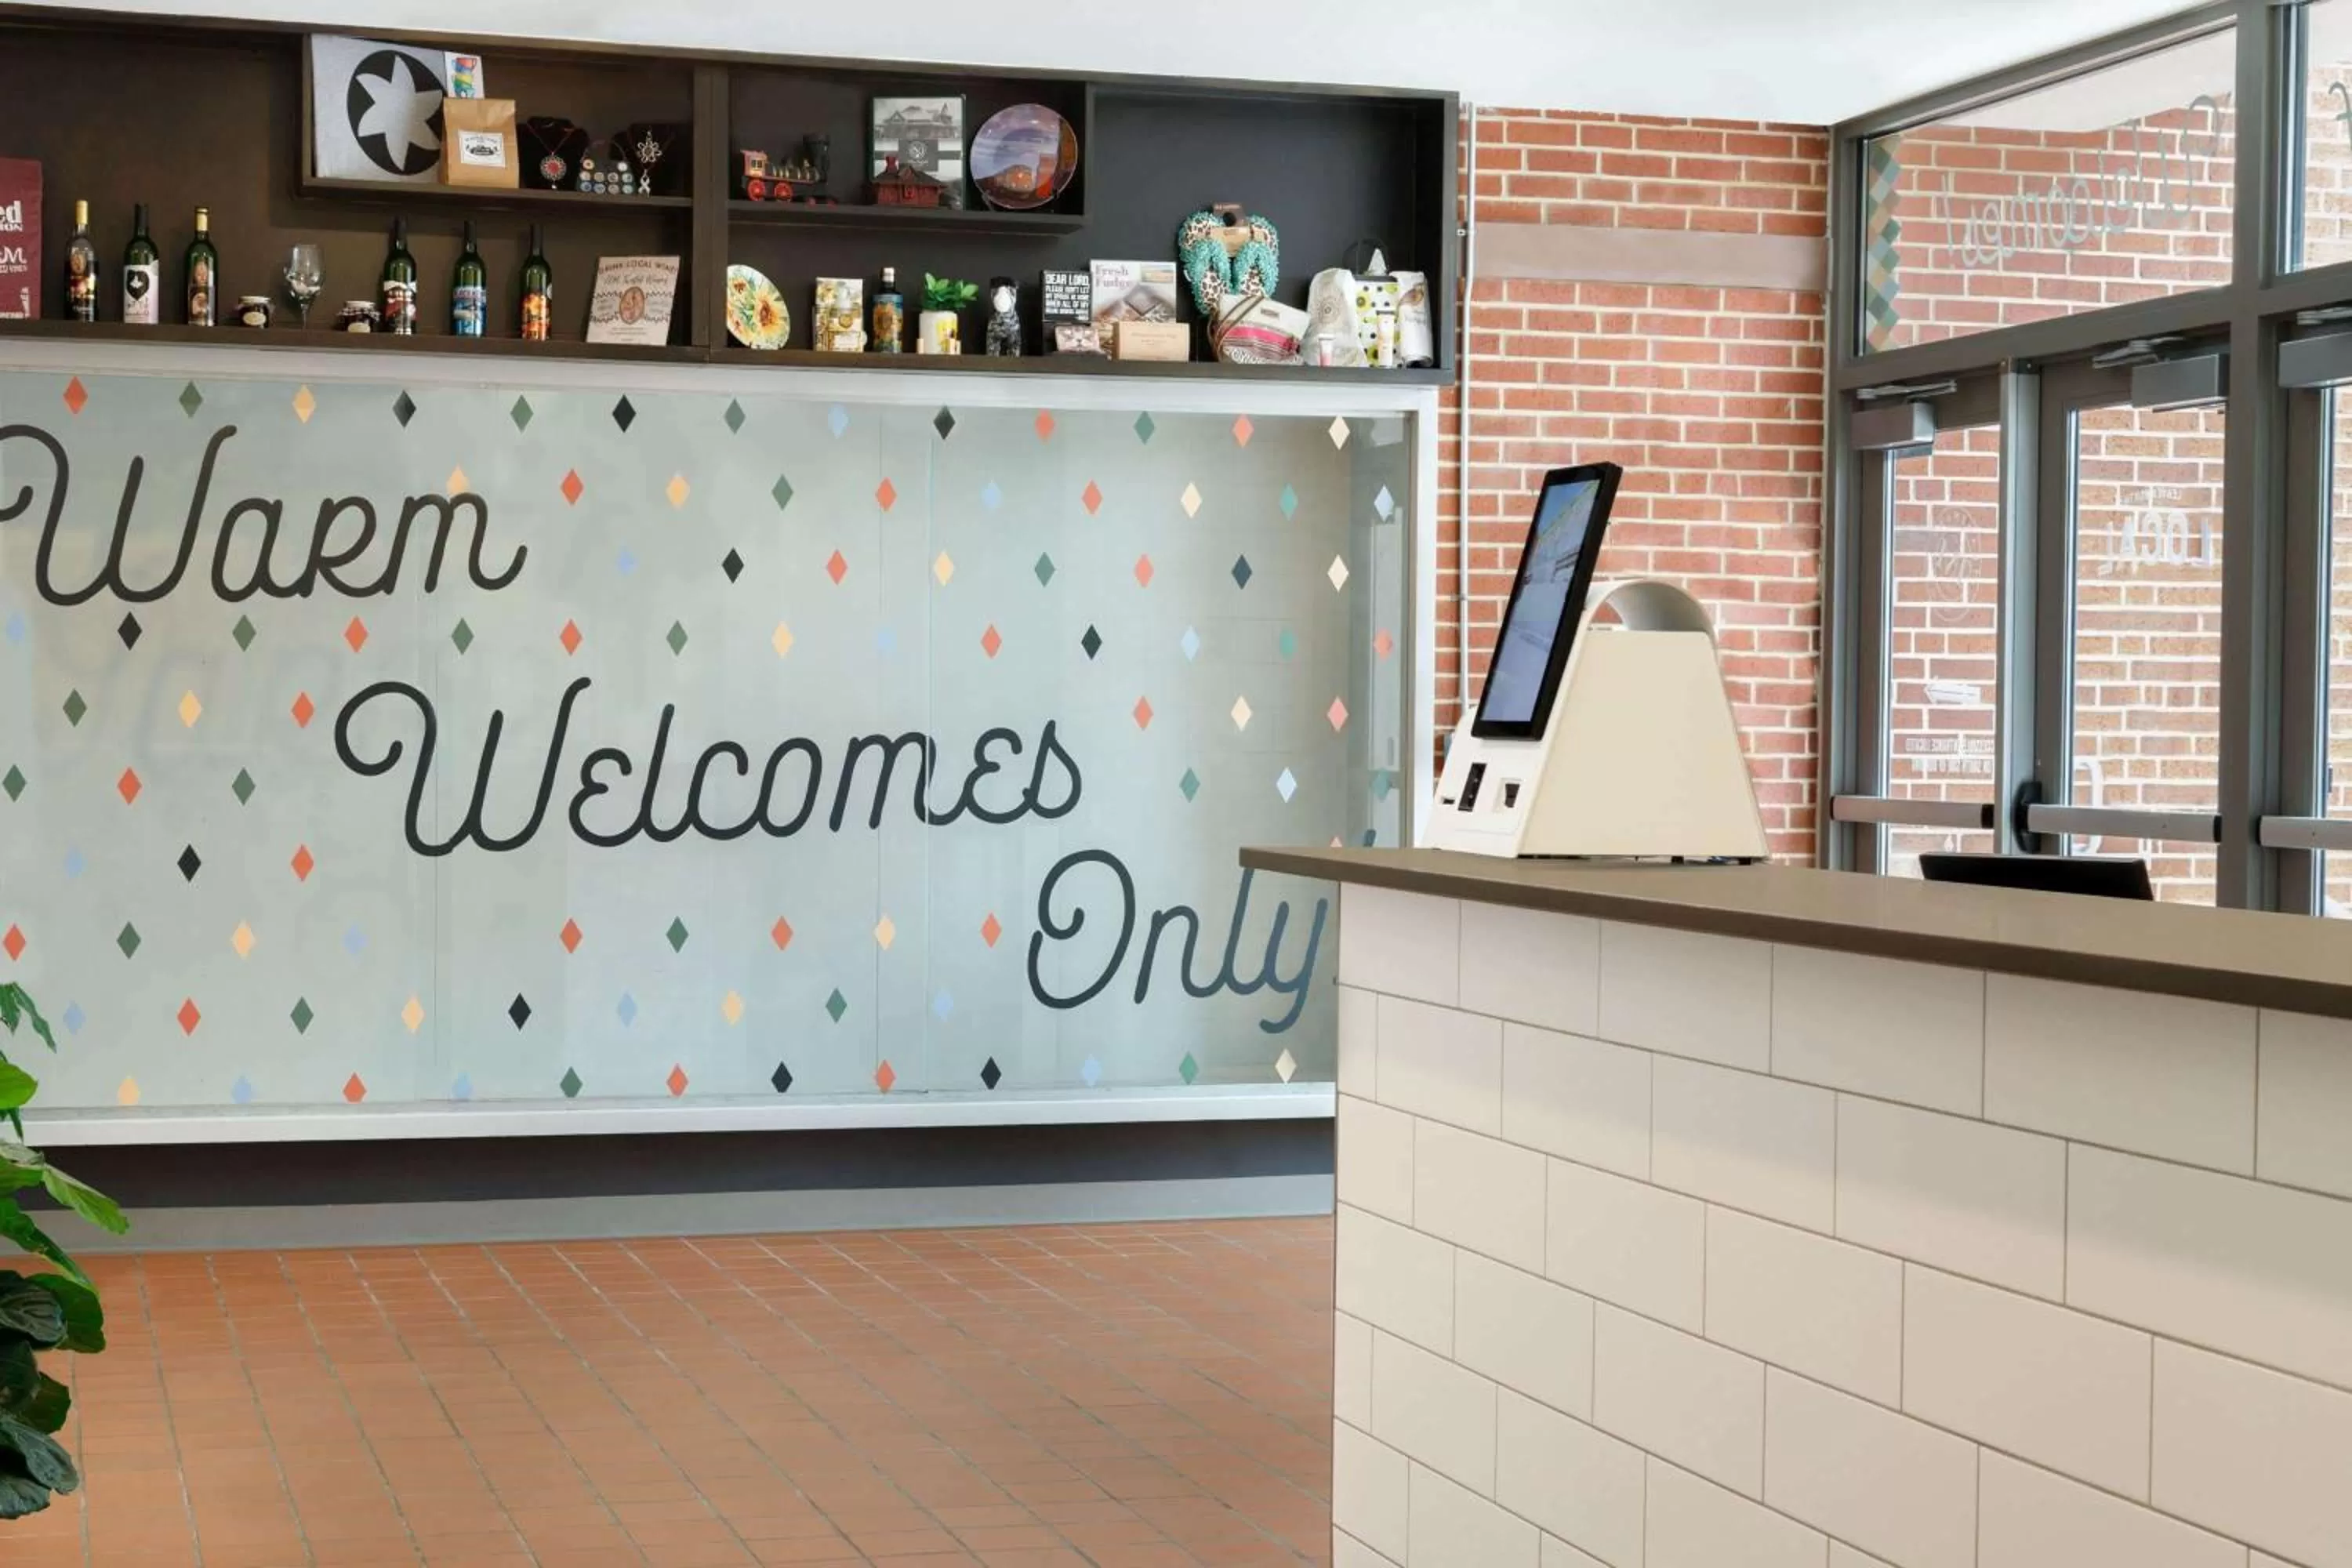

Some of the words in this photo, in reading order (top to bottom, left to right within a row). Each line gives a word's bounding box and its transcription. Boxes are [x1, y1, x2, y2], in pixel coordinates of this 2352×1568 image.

[1045, 274, 1067, 285] DEAR
[335, 677, 1081, 857] Welcomes
[1027, 849, 1329, 1033] Only
